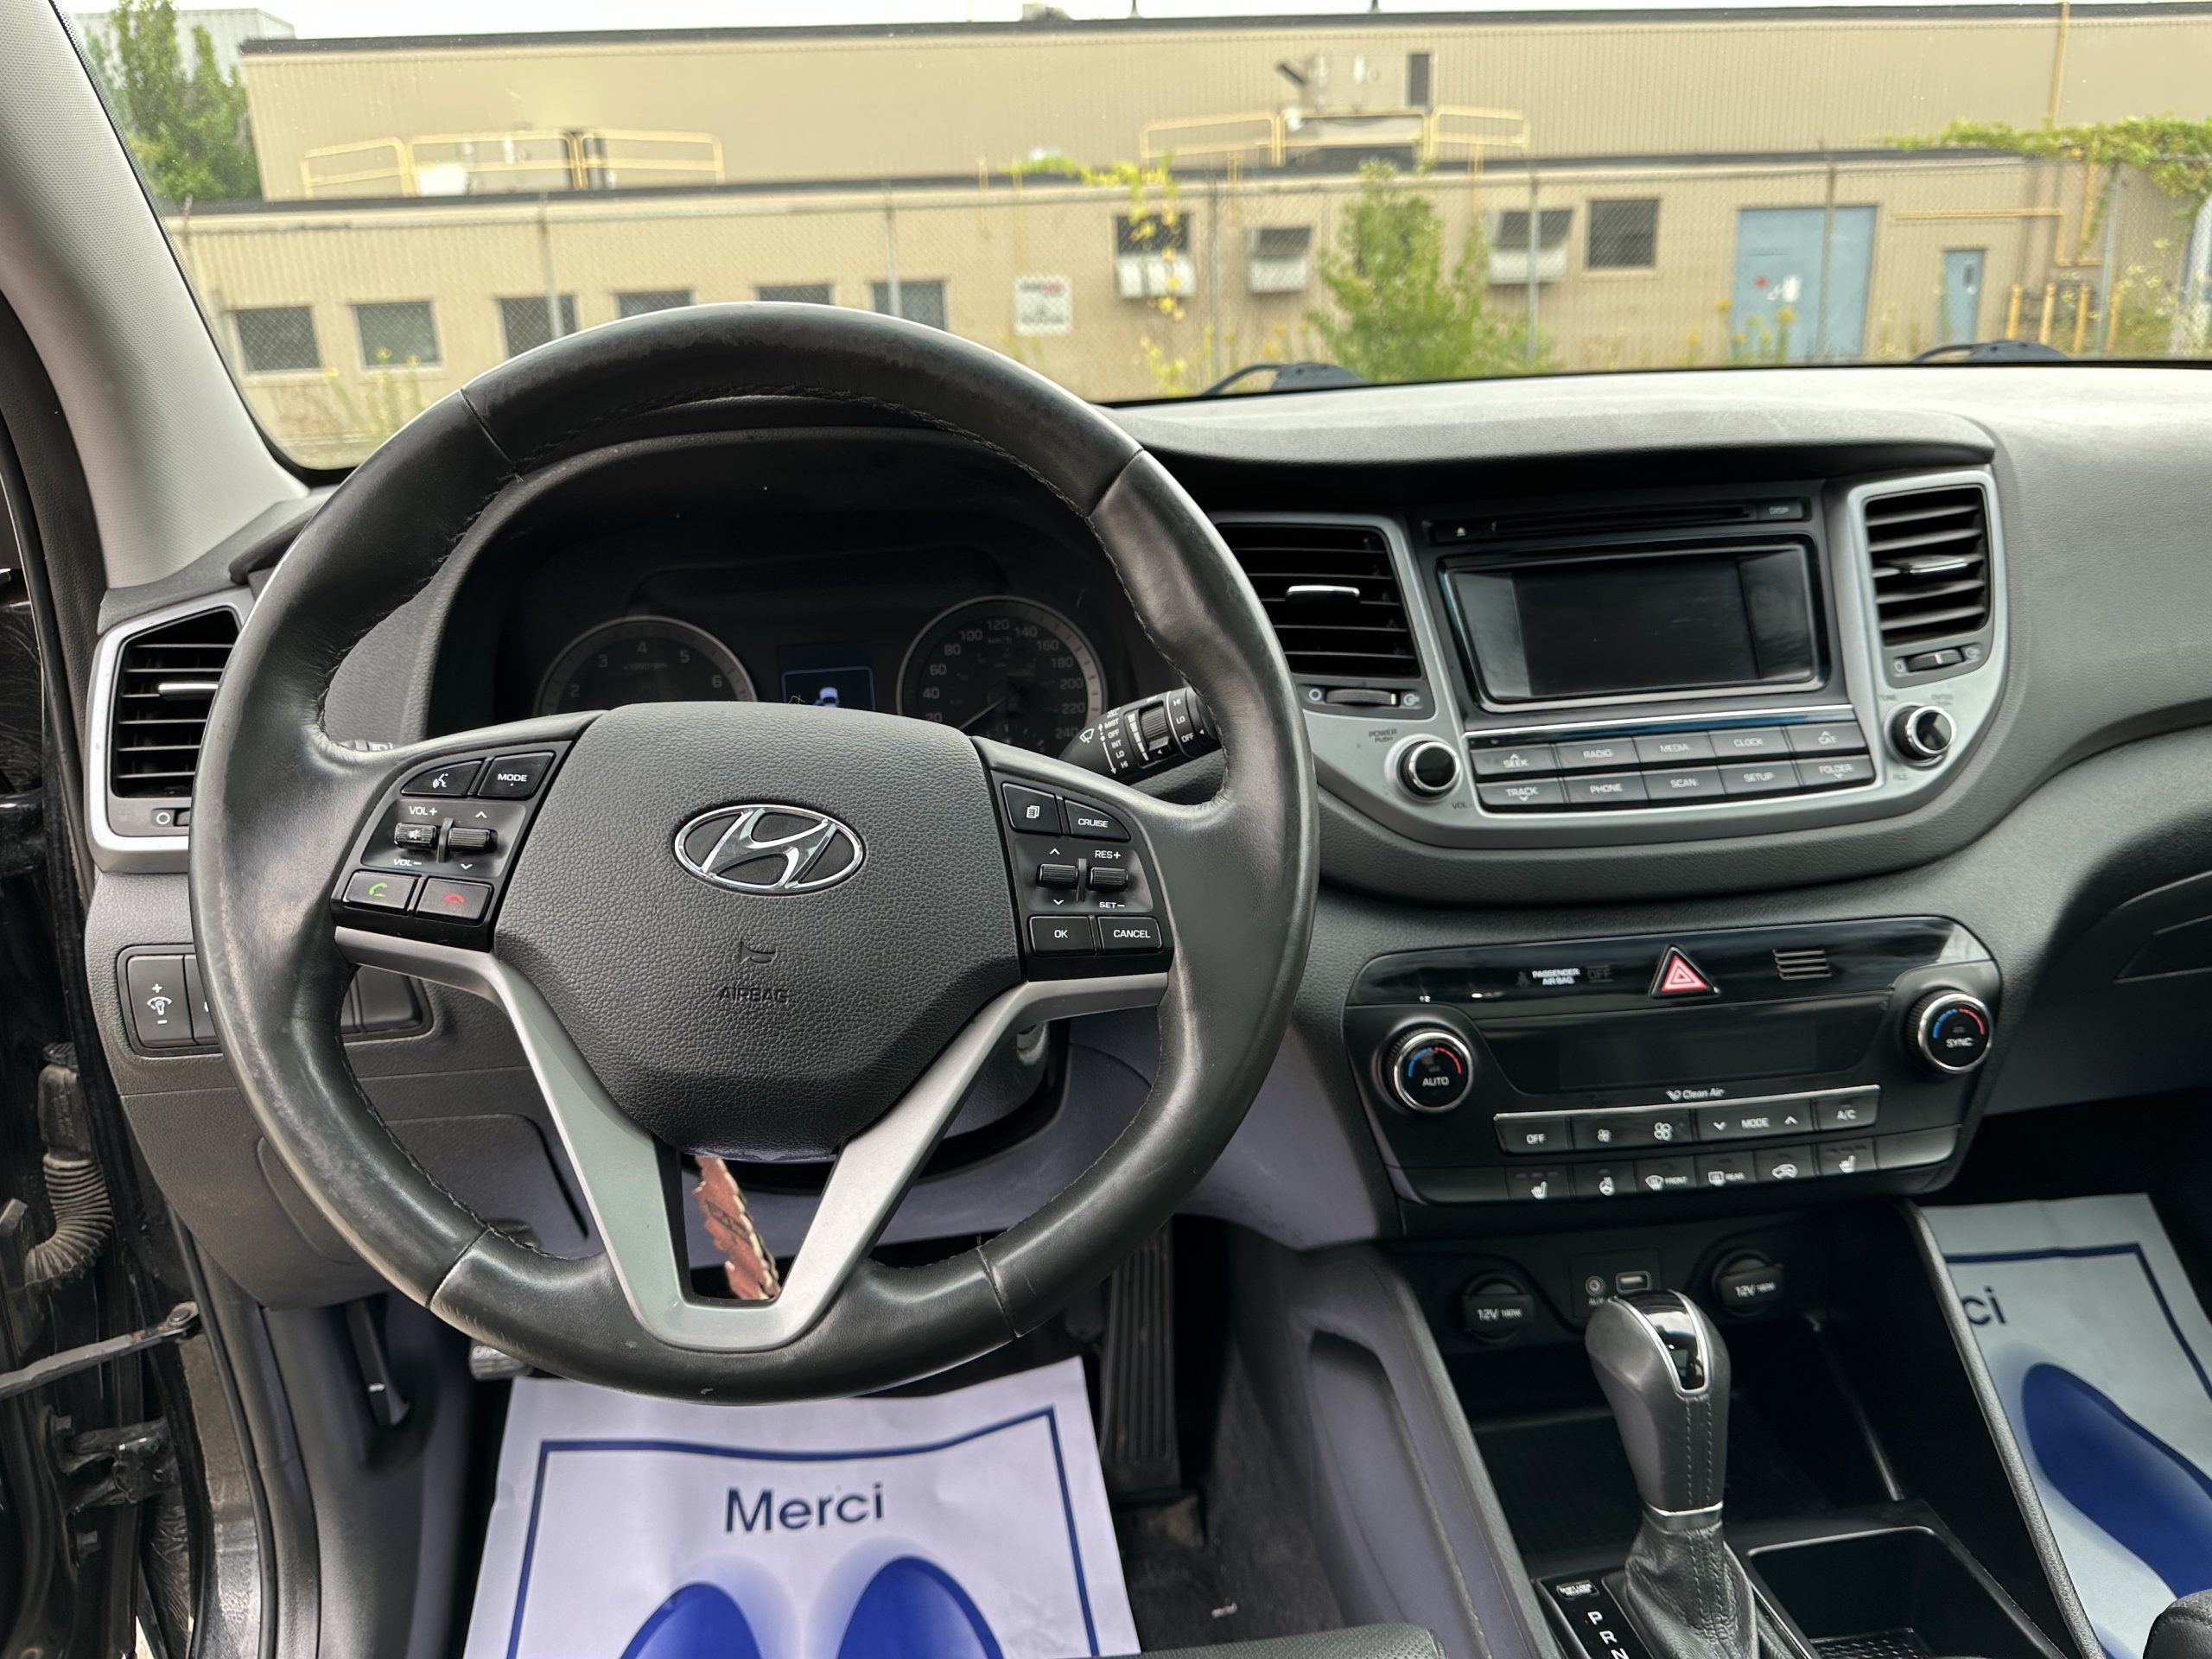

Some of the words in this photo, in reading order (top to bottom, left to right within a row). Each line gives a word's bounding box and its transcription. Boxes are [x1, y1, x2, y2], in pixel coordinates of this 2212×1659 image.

[987, 619, 1009, 631] 120
[959, 629, 983, 642] 100
[1015, 626, 1038, 638] 140
[637, 640, 648, 654] 4
[944, 643, 961, 656] 80
[1037, 639, 1059, 652] 160
[597, 654, 608, 668] 3
[679, 650, 690, 664] 5
[1051, 657, 1074, 669] 180
[930, 664, 947, 676] 60
[711, 674, 722, 689] 6
[1059, 677, 1084, 690] 200
[569, 683, 580, 697] 2
[922, 687, 940, 699] 40
[1173, 698, 1181, 707] HI
[1061, 702, 1085, 715] 220
[1104, 718, 1120, 729] MIST
[1176, 715, 1185, 725] LO
[1108, 728, 1120, 739] OFF
[1181, 733, 1194, 743] OFF
[1368, 728, 1397, 737] POWER
[1111, 740, 1122, 749] INT
[1733, 738, 1764, 747] CLOCK
[1818, 735, 1838, 745] CAT
[1660, 743, 1690, 753] MEDIA
[1116, 750, 1125, 760] LO
[1583, 749, 1613, 760] RADIO
[1120, 760, 1129, 769] HI
[1503, 759, 1529, 768] SEEK
[1819, 764, 1853, 774] FOLDER
[498, 773, 528, 782] MODE
[1744, 772, 1776, 782] SETUP
[1590, 783, 1624, 793] PHONE
[1670, 779, 1698, 789] SCAN
[1505, 786, 1539, 797] TRACK
[1077, 818, 1109, 828] CRUISE
[1054, 929, 1068, 938] OK
[1113, 929, 1151, 938] CANCEL
[1532, 968, 1581, 978] PASSENGER
[1588, 968, 1611, 979] OFF
[719, 986, 790, 1003] AIRBAG
[1946, 1038, 1974, 1048] SYNC
[1422, 1076, 1450, 1087] AUTO
[1682, 1088, 1708, 1100] Clean
[1709, 1087, 1725, 1097] Air
[1836, 1108, 1856, 1121] A/C
[1741, 1117, 1770, 1128] MODE
[1526, 1133, 1546, 1144] OFF
[1665, 1175, 1688, 1185] FRONT
[1726, 1172, 1745, 1181] REAR
[1734, 1283, 1756, 1298] 12V
[1477, 1307, 1499, 1322] 12V
[724, 1481, 886, 1534] Merci
[1587, 1611, 1603, 1625] P
[1599, 1630, 1618, 1644] R
